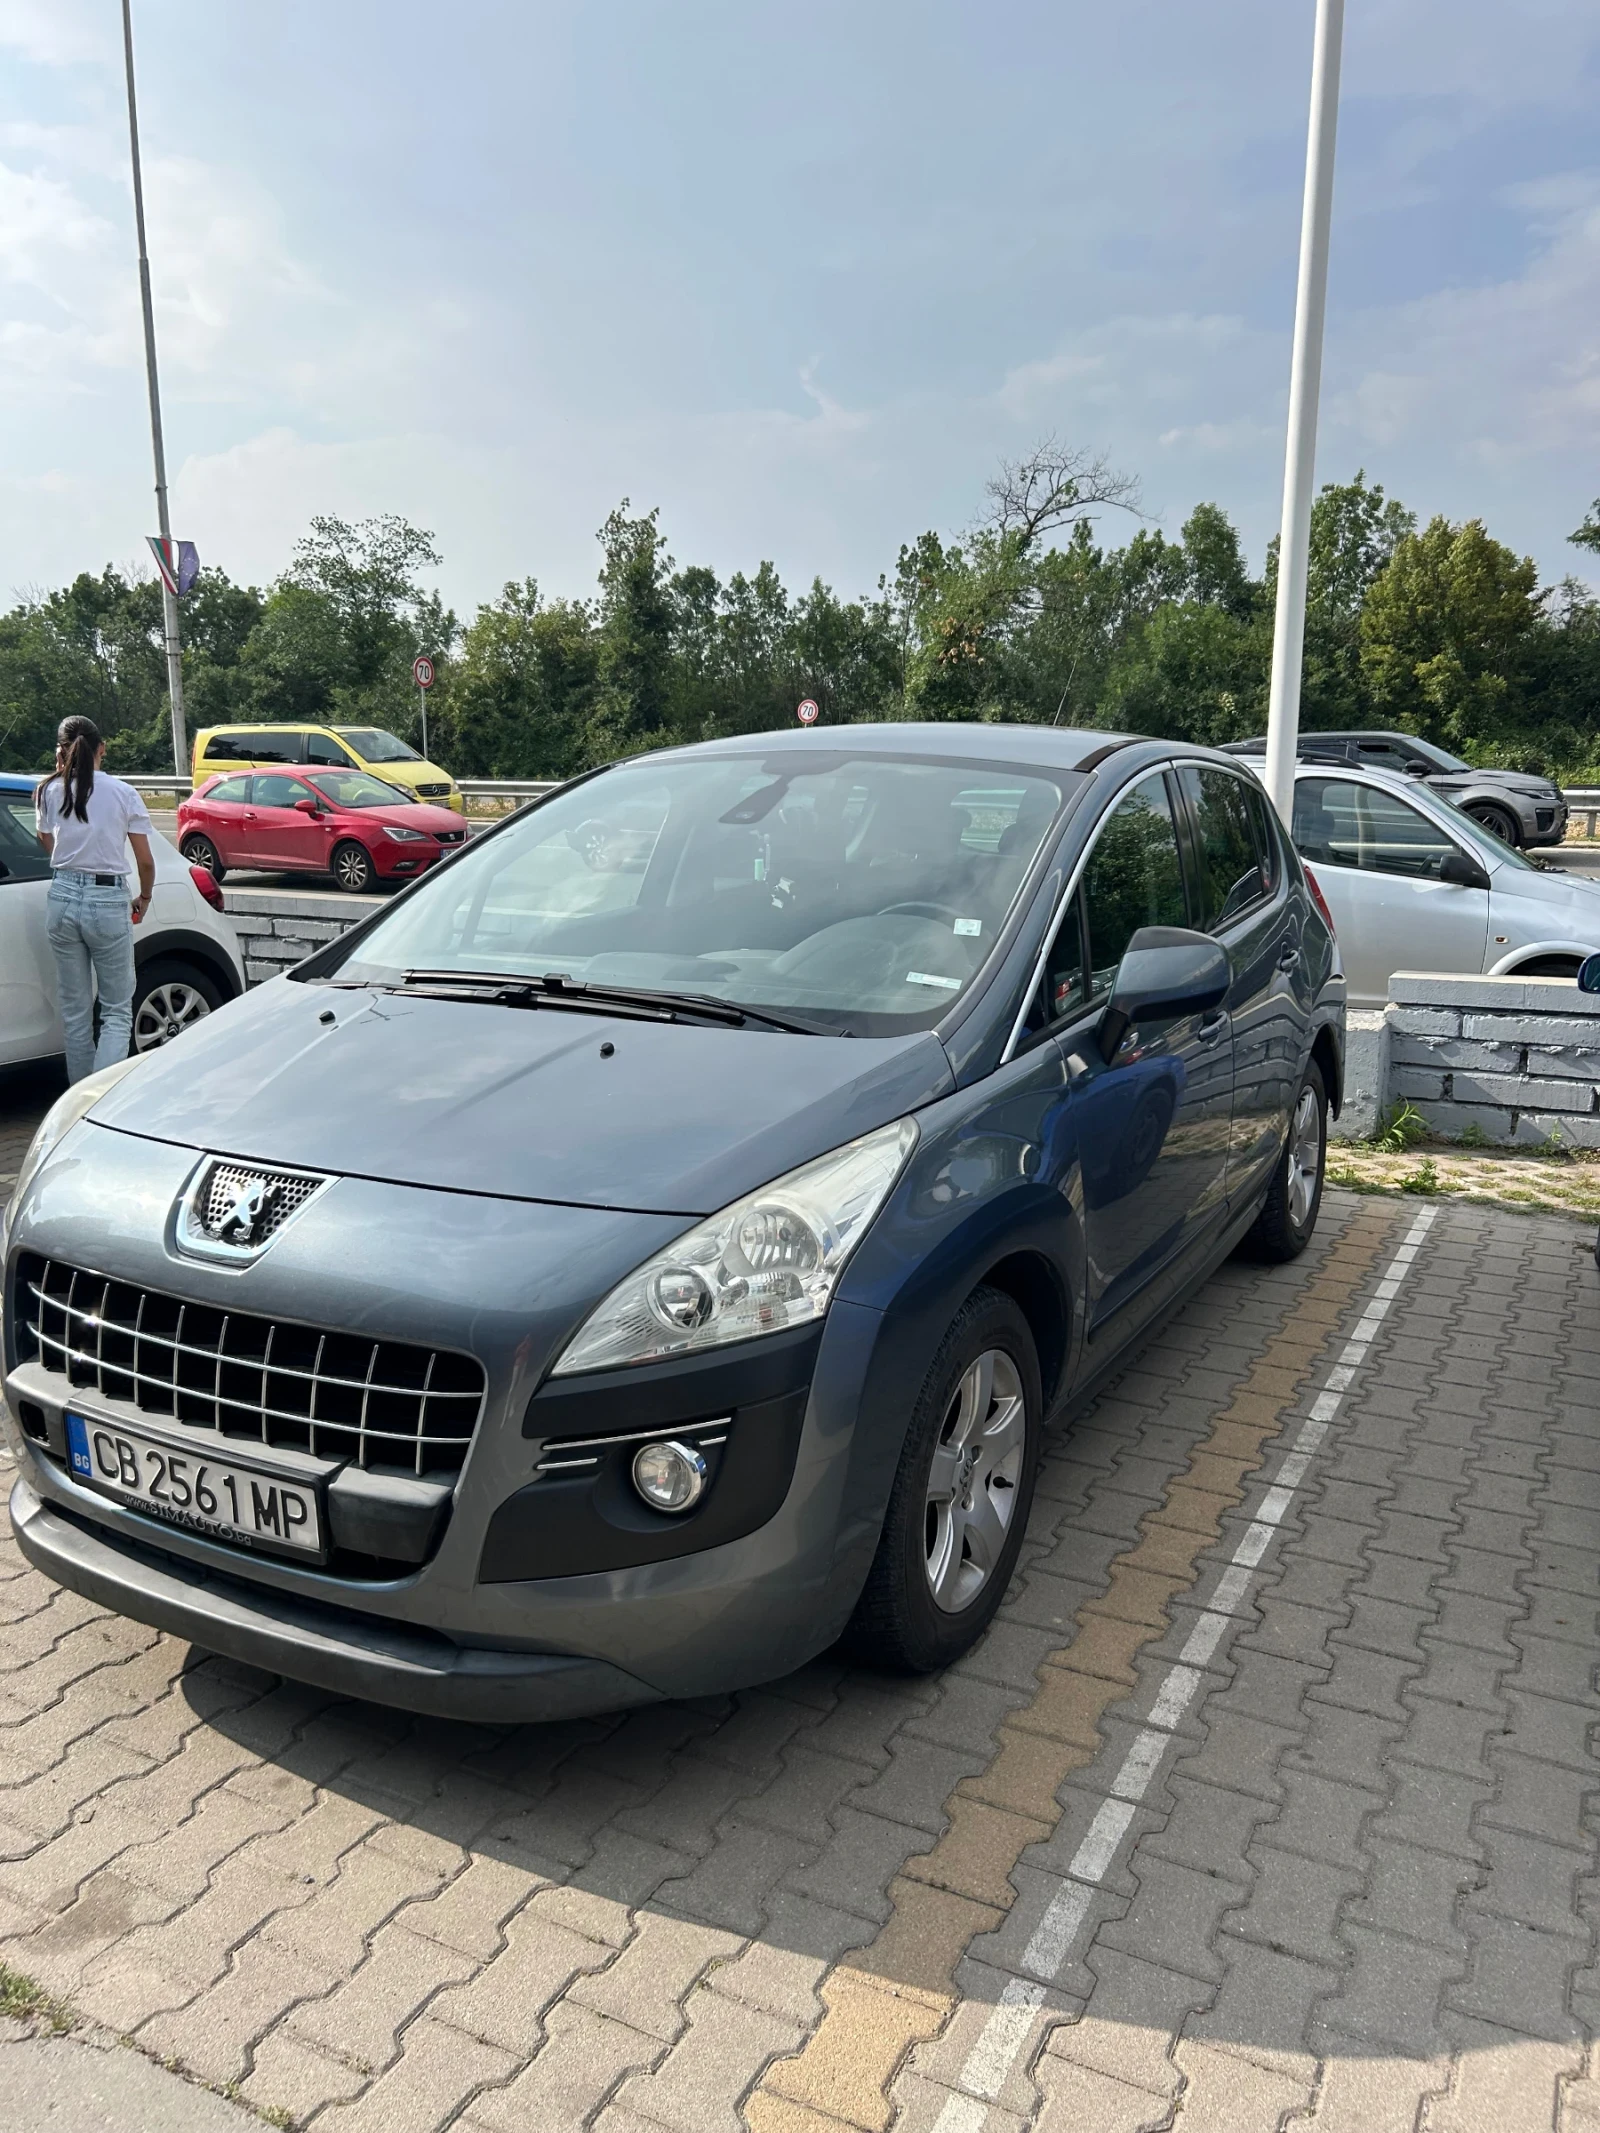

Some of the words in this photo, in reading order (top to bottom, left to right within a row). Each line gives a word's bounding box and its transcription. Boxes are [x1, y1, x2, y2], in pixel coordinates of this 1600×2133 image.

[419, 665, 430, 680] 70
[803, 705, 814, 717] 70
[74, 1452, 90, 1469] BG
[93, 1430, 139, 1488] CB
[146, 1449, 240, 1524] 2561
[250, 1481, 308, 1539] MP
